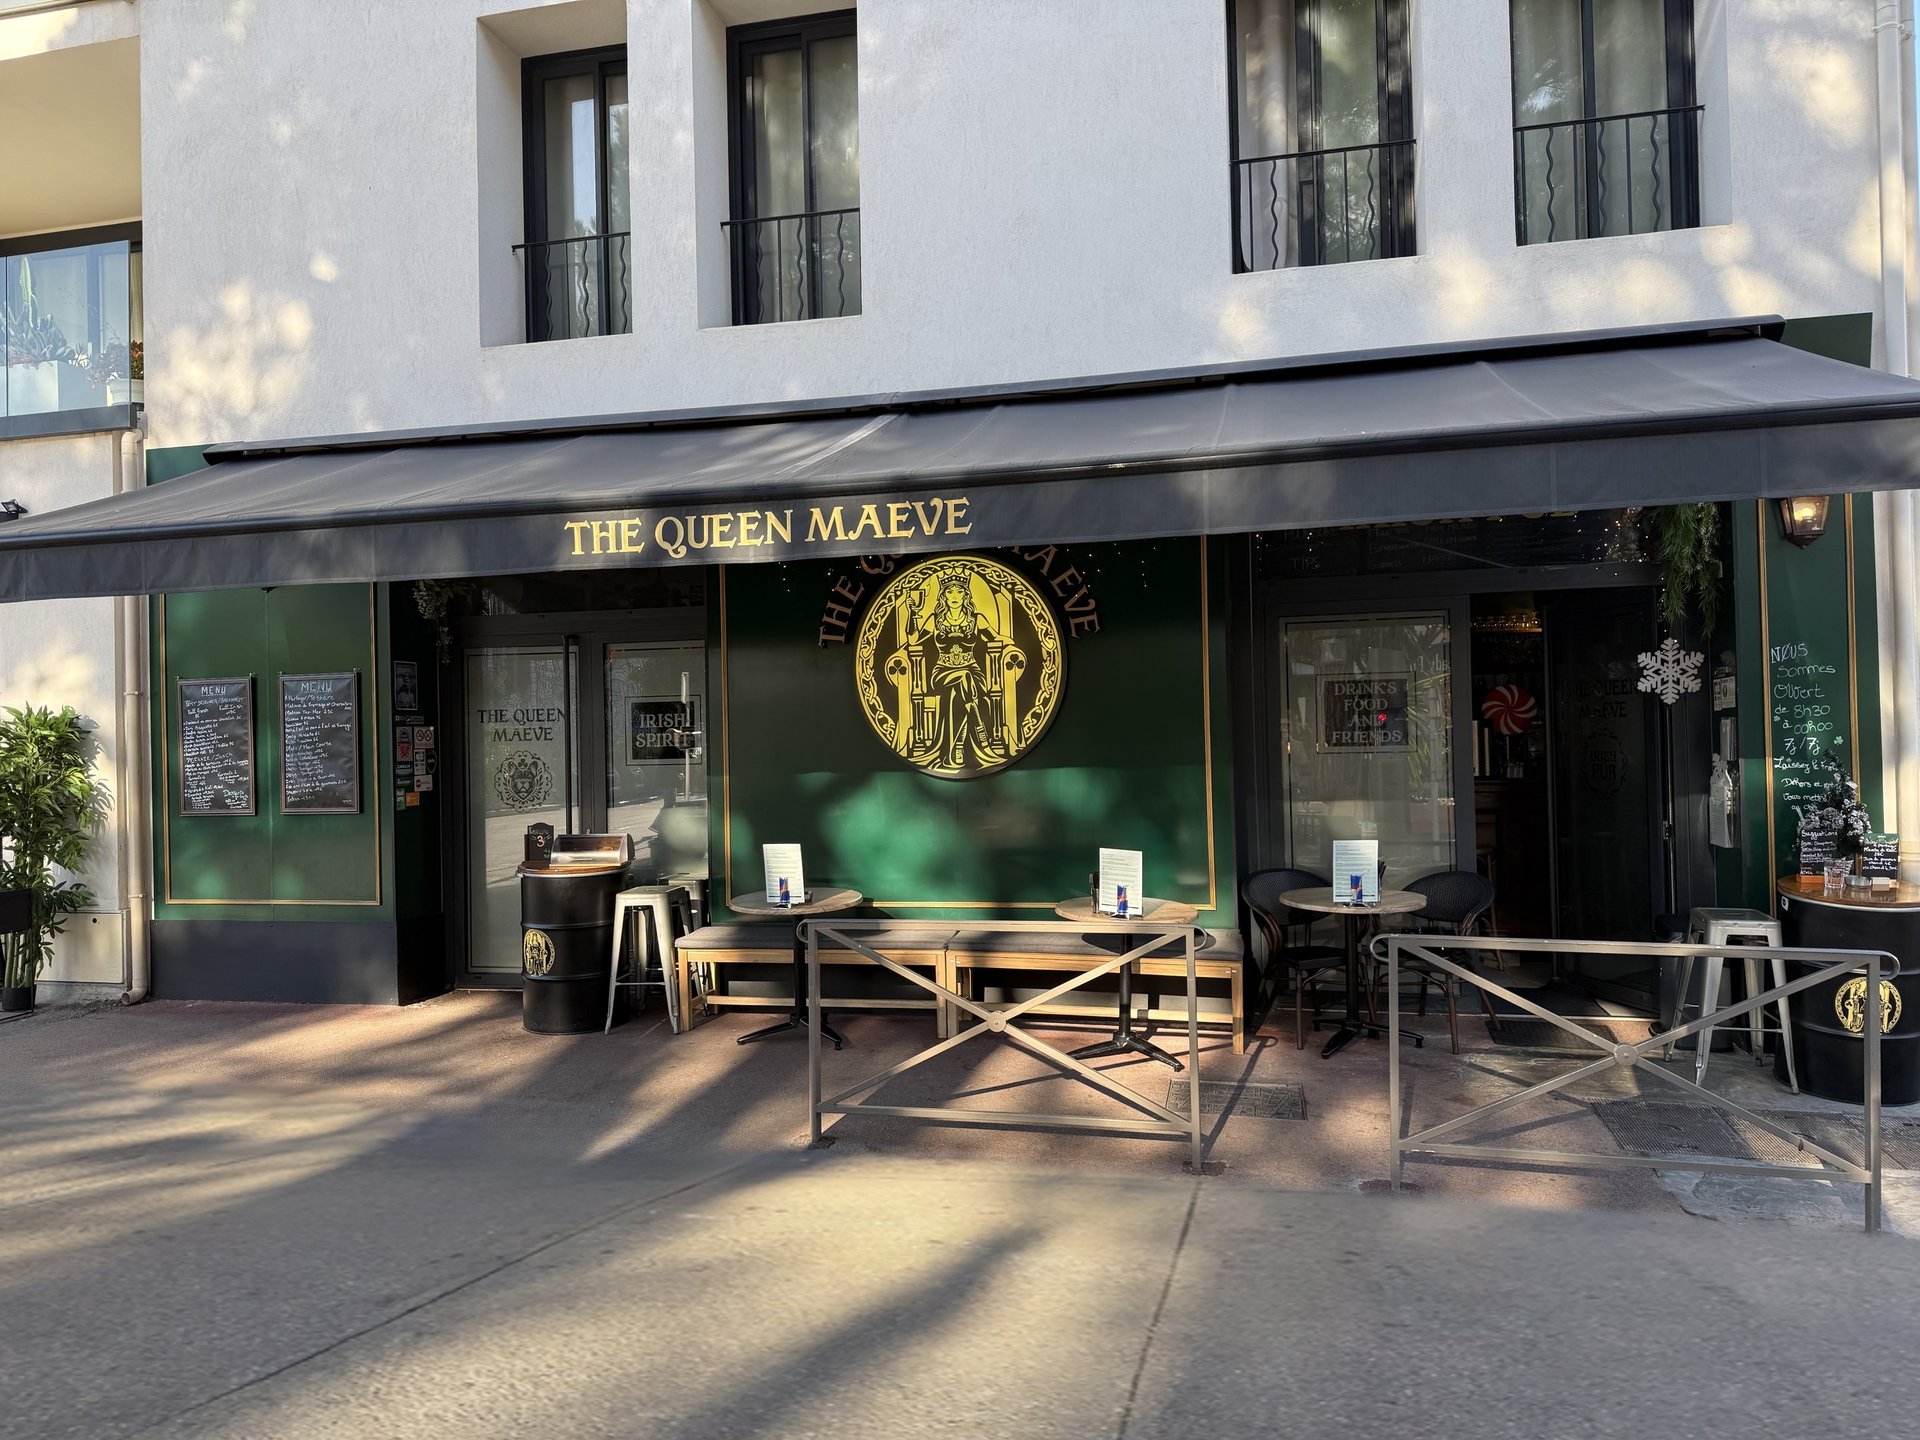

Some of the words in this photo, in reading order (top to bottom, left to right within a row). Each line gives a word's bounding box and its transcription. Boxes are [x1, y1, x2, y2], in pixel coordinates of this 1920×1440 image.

[564, 517, 646, 556] THE
[654, 509, 794, 559] QUEEN
[804, 497, 973, 542] MAEVE
[817, 575, 866, 649] THE
[1011, 544, 1102, 639] AEVE
[201, 686, 226, 695] MENU
[301, 681, 332, 691] MENU
[1344, 698, 1388, 712] FOOD
[1793, 704, 1831, 718] 8h30
[477, 709, 509, 724] THE
[513, 708, 566, 726] QUEEN
[640, 713, 686, 728] IRISH
[1347, 714, 1384, 727] AND
[492, 727, 554, 742] MAEVE
[635, 733, 690, 748] SPIRIT
[1332, 730, 1402, 744] FRIENDS
[537, 835, 545, 848] 3
